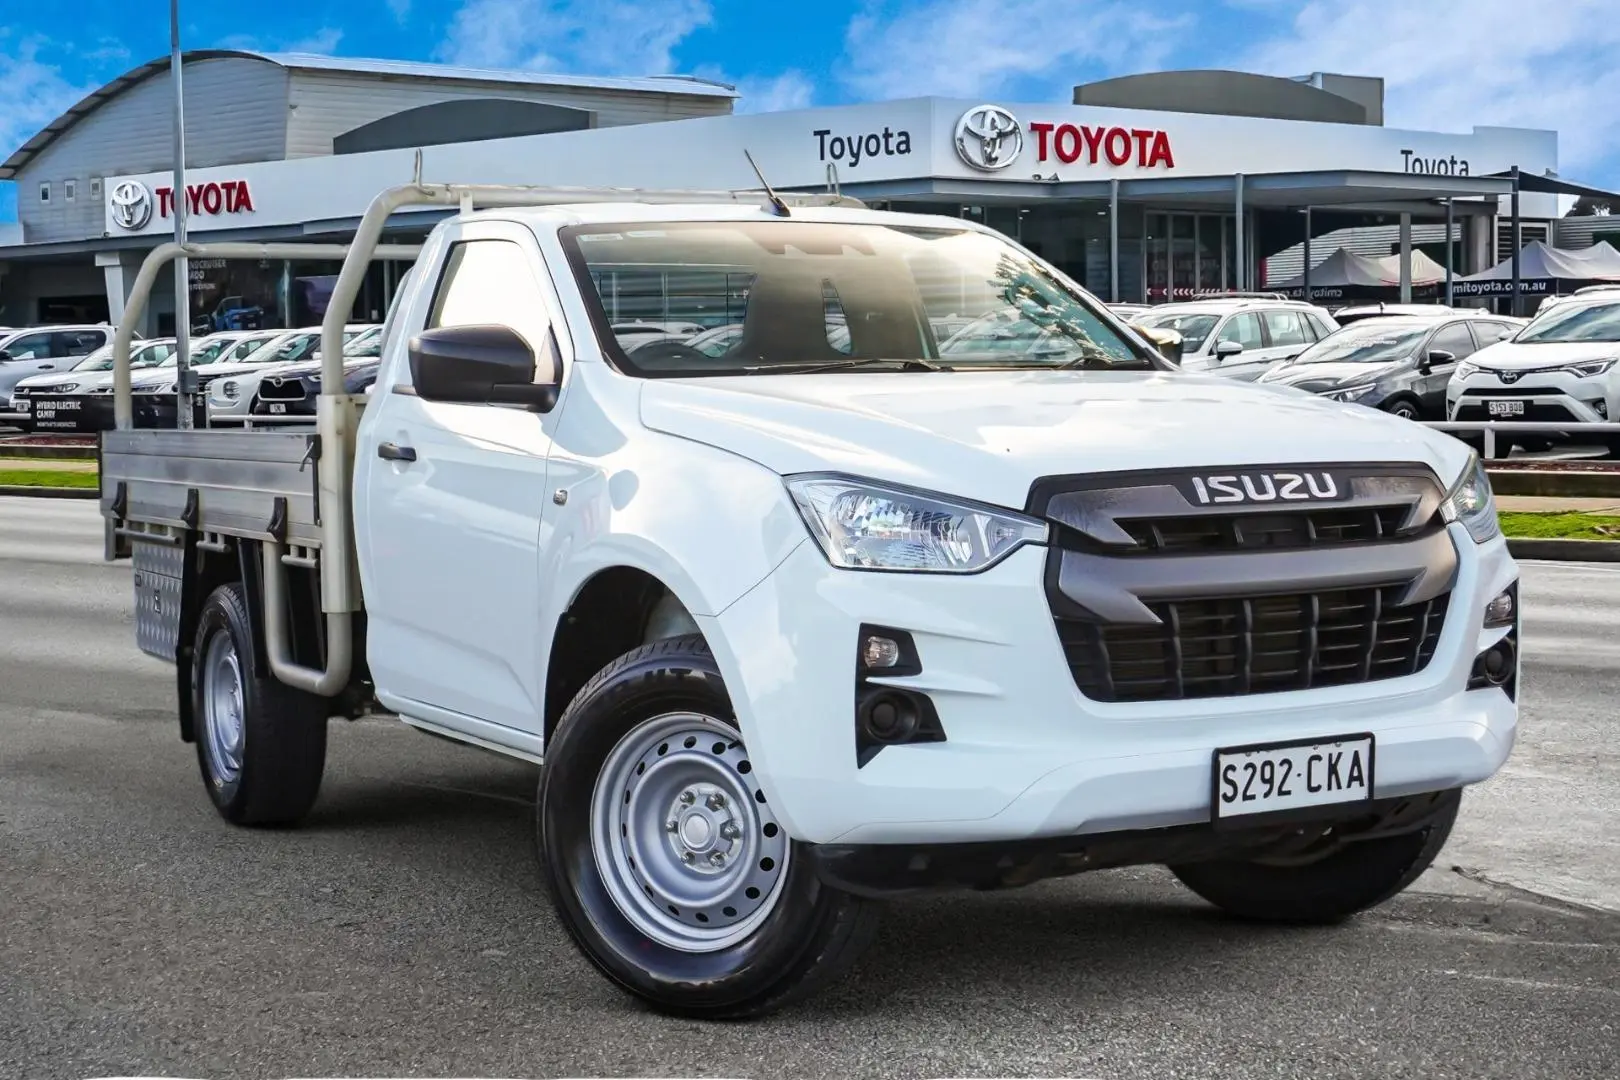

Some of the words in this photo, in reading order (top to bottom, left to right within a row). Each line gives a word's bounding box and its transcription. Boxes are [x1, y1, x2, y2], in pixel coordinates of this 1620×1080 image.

[813, 127, 911, 167] Toyota
[1030, 122, 1174, 168] TOYOTA
[1453, 281, 1546, 294] mitoyota.cm.au
[1192, 472, 1338, 504] ISUZU
